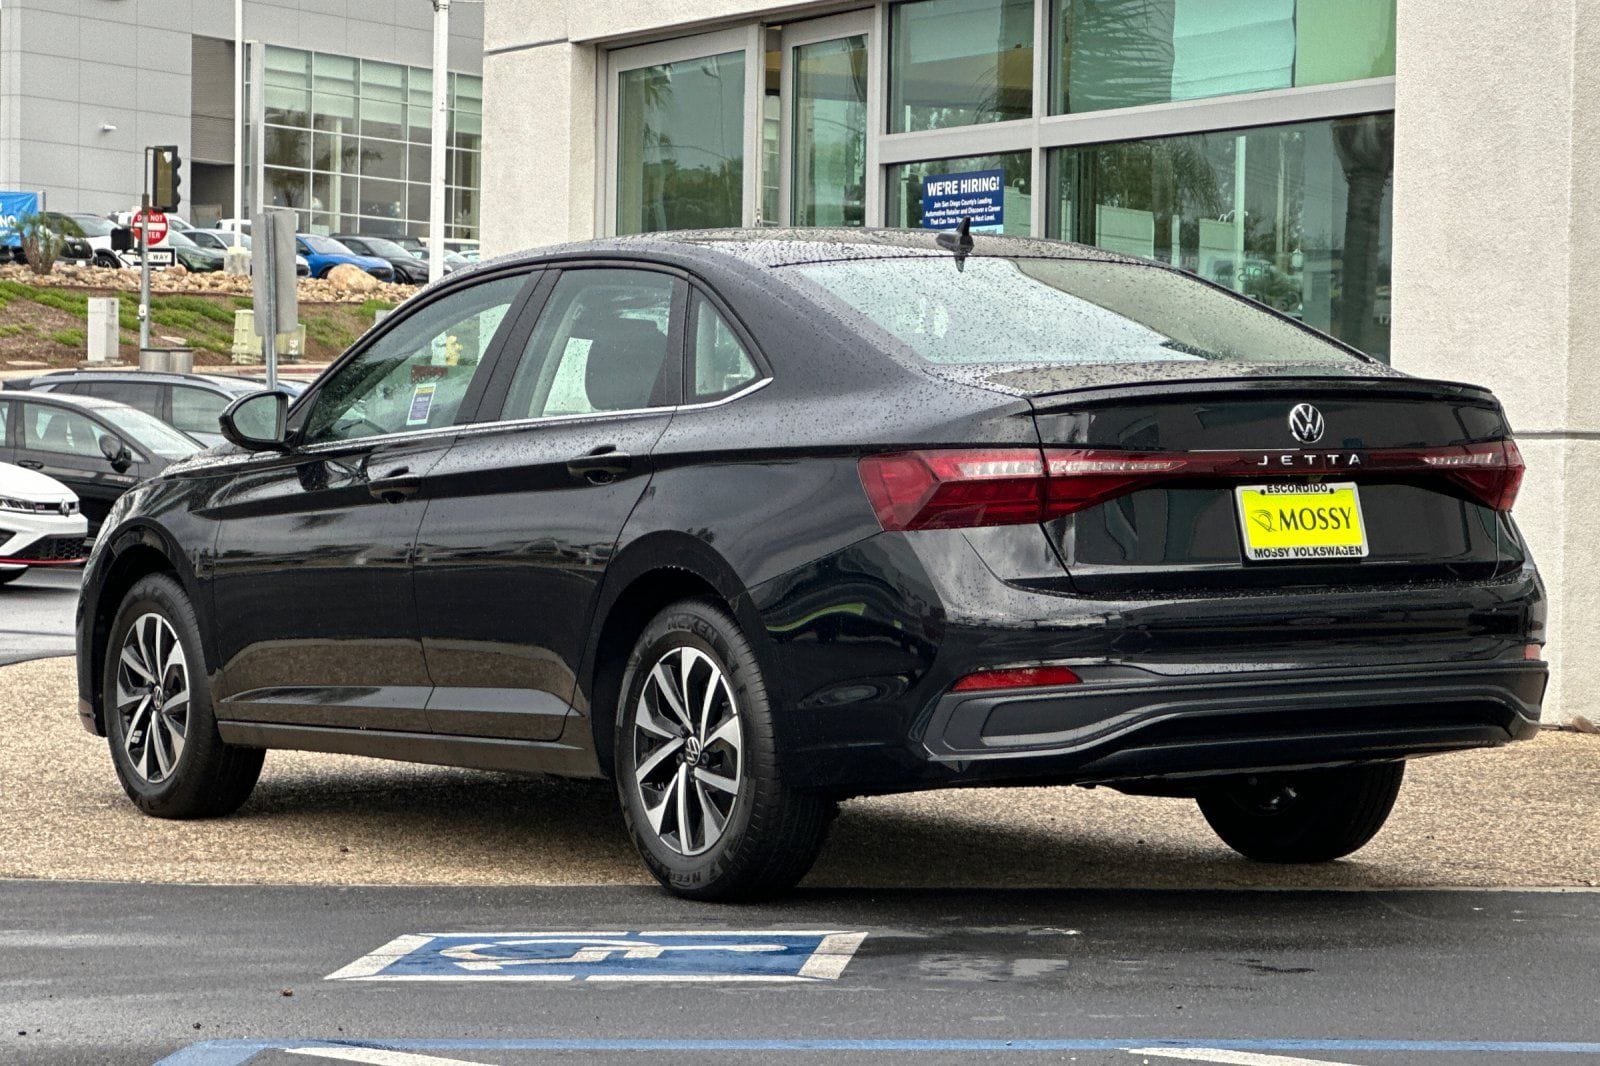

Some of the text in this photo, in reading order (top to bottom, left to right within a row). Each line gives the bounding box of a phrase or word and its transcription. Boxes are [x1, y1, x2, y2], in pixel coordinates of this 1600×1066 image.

[927, 176, 1000, 197] WE'RE HIRING!
[150, 214, 163, 222] NOT
[1257, 454, 1361, 466] JETTA
[1267, 484, 1328, 494] ESCONDIDO
[1279, 507, 1351, 531] MOSSY
[1254, 545, 1363, 558] MOSSY VOLKSWAGEN
